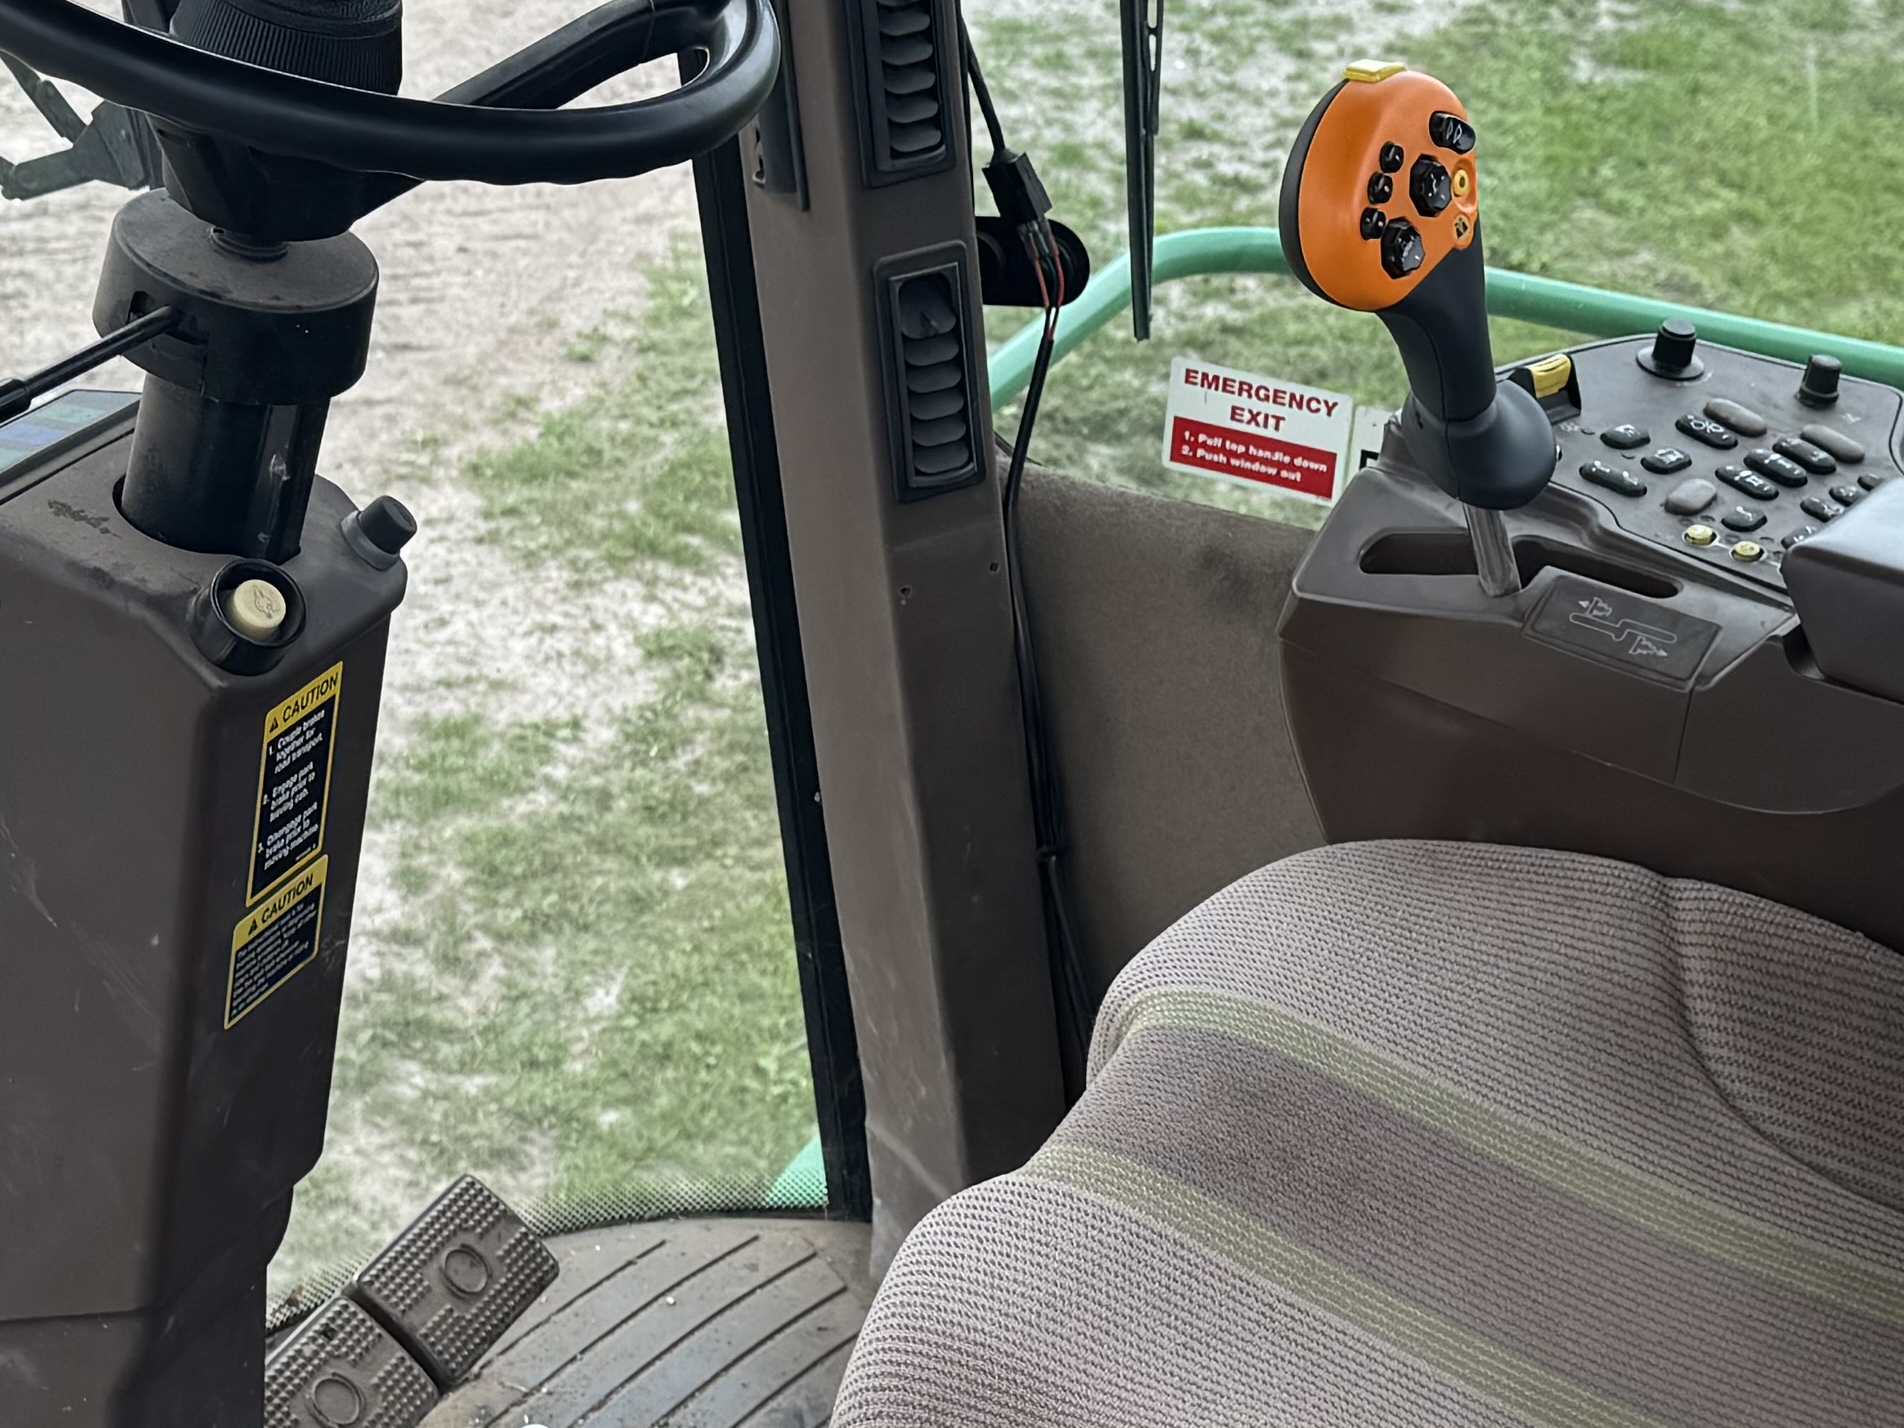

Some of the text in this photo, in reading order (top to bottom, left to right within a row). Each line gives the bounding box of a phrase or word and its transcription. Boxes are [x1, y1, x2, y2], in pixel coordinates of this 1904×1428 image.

[1184, 368, 1339, 418] EMERGENCY
[1230, 405, 1286, 432] EXIT
[1196, 448, 1227, 464] Push
[1230, 456, 1278, 476] window
[1280, 469, 1302, 483] out
[1198, 433, 1223, 448] Pull
[1225, 439, 1247, 454] top
[1248, 444, 1291, 464] handle
[1293, 456, 1327, 473] down
[283, 672, 338, 722] CAUTION
[261, 872, 314, 923] CAUTION
